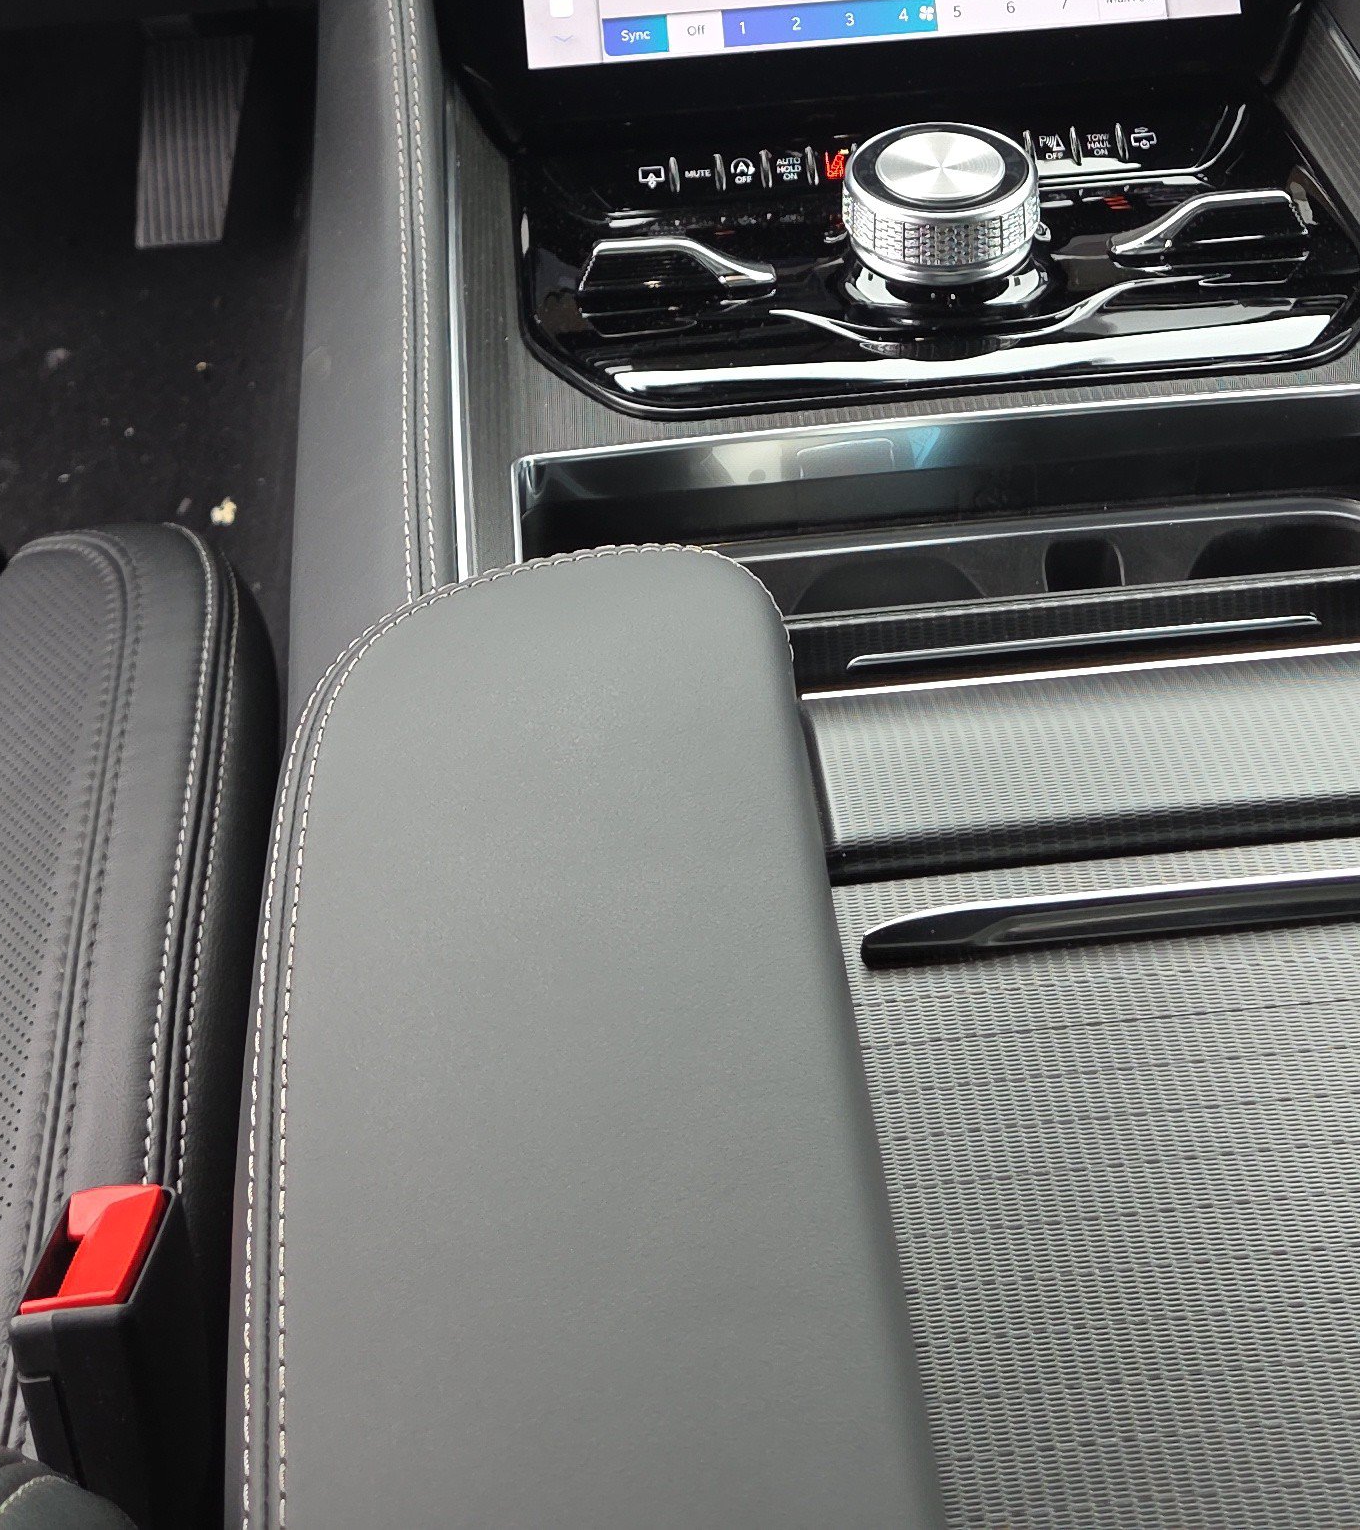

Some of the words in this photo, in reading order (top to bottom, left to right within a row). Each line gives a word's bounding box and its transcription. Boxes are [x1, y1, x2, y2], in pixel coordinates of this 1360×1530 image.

[620, 28, 652, 42] Sync
[687, 24, 706, 37] Off
[740, 21, 746, 35] 1
[791, 17, 802, 31] 2
[844, 12, 855, 27] 3
[898, 7, 909, 21] 4
[952, 5, 962, 18] 5
[1006, 0, 1016, 14] 6
[1087, 141, 1111, 149] HAUL
[1093, 147, 1109, 156] ON
[776, 156, 801, 166] AUTO
[685, 169, 712, 179] MUTE
[776, 165, 802, 174] HOLD
[783, 173, 798, 181] ON
